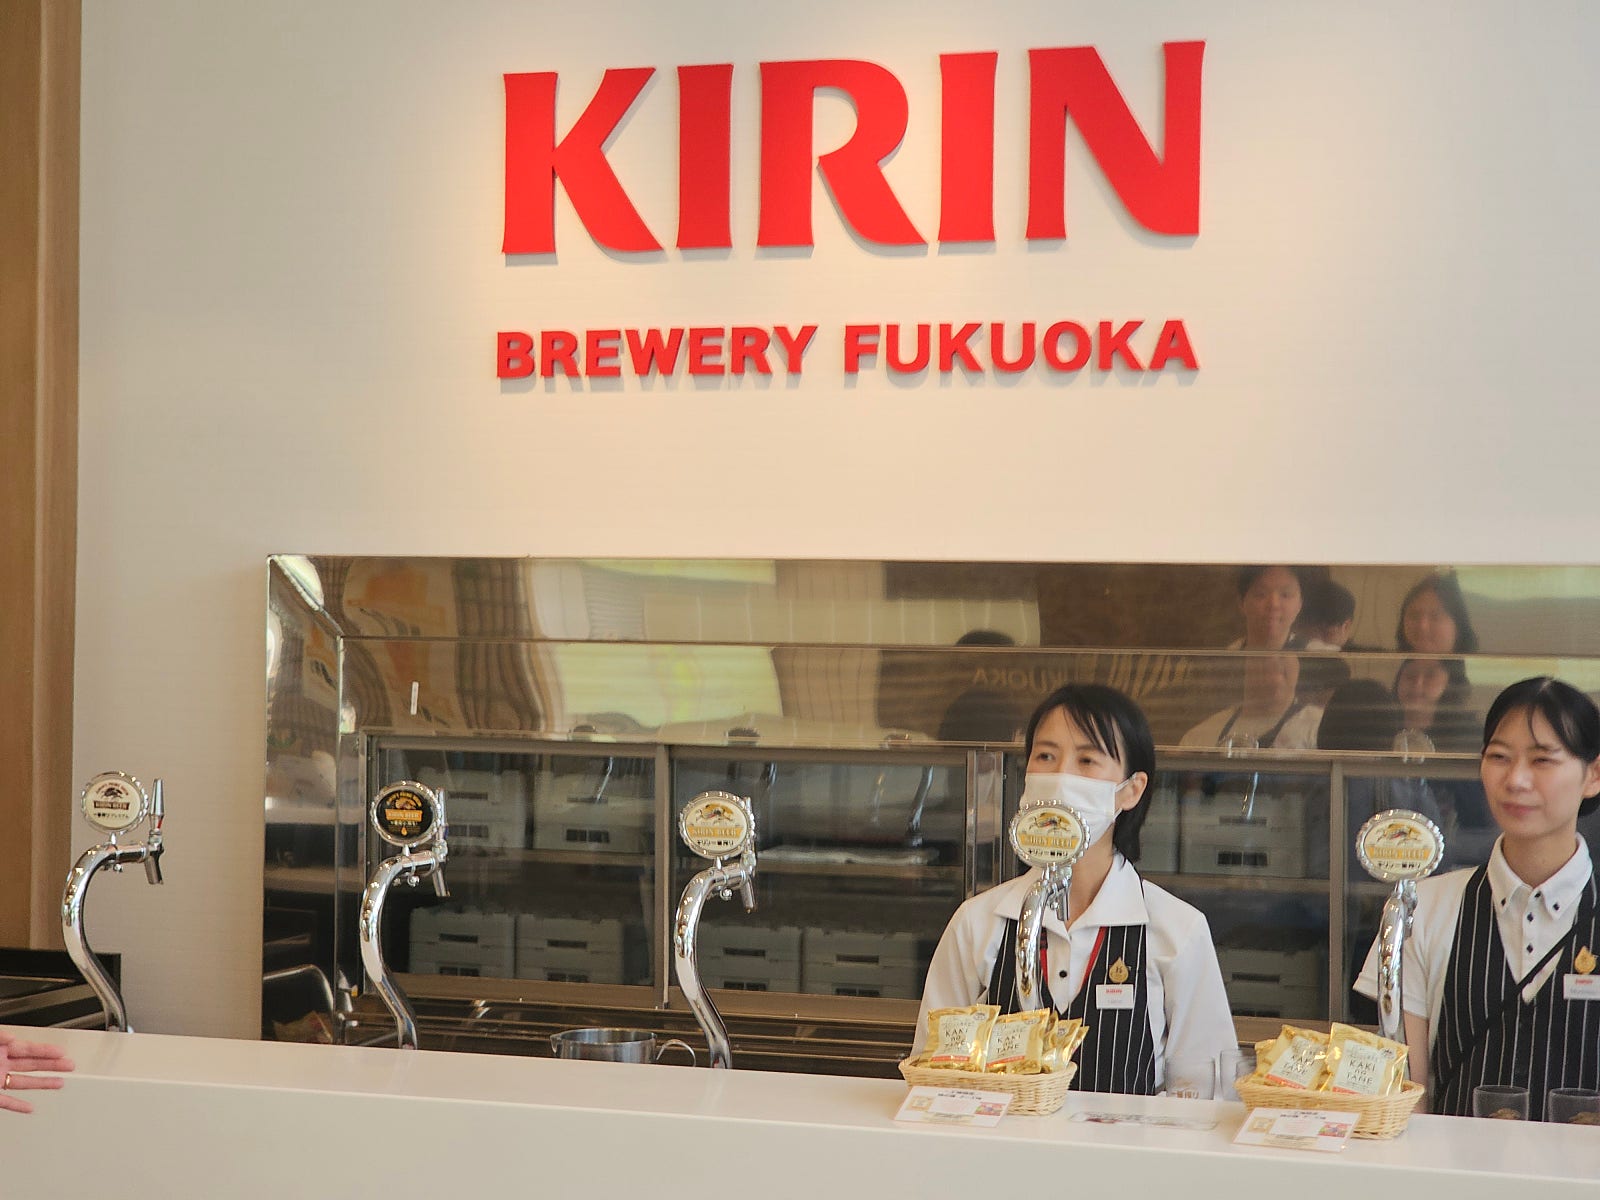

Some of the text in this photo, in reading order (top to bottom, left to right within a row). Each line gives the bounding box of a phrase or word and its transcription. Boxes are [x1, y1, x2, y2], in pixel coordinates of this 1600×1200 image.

[502, 40, 1205, 254] KIRIN
[497, 319, 1199, 379] BREWERY FUKUOKA
